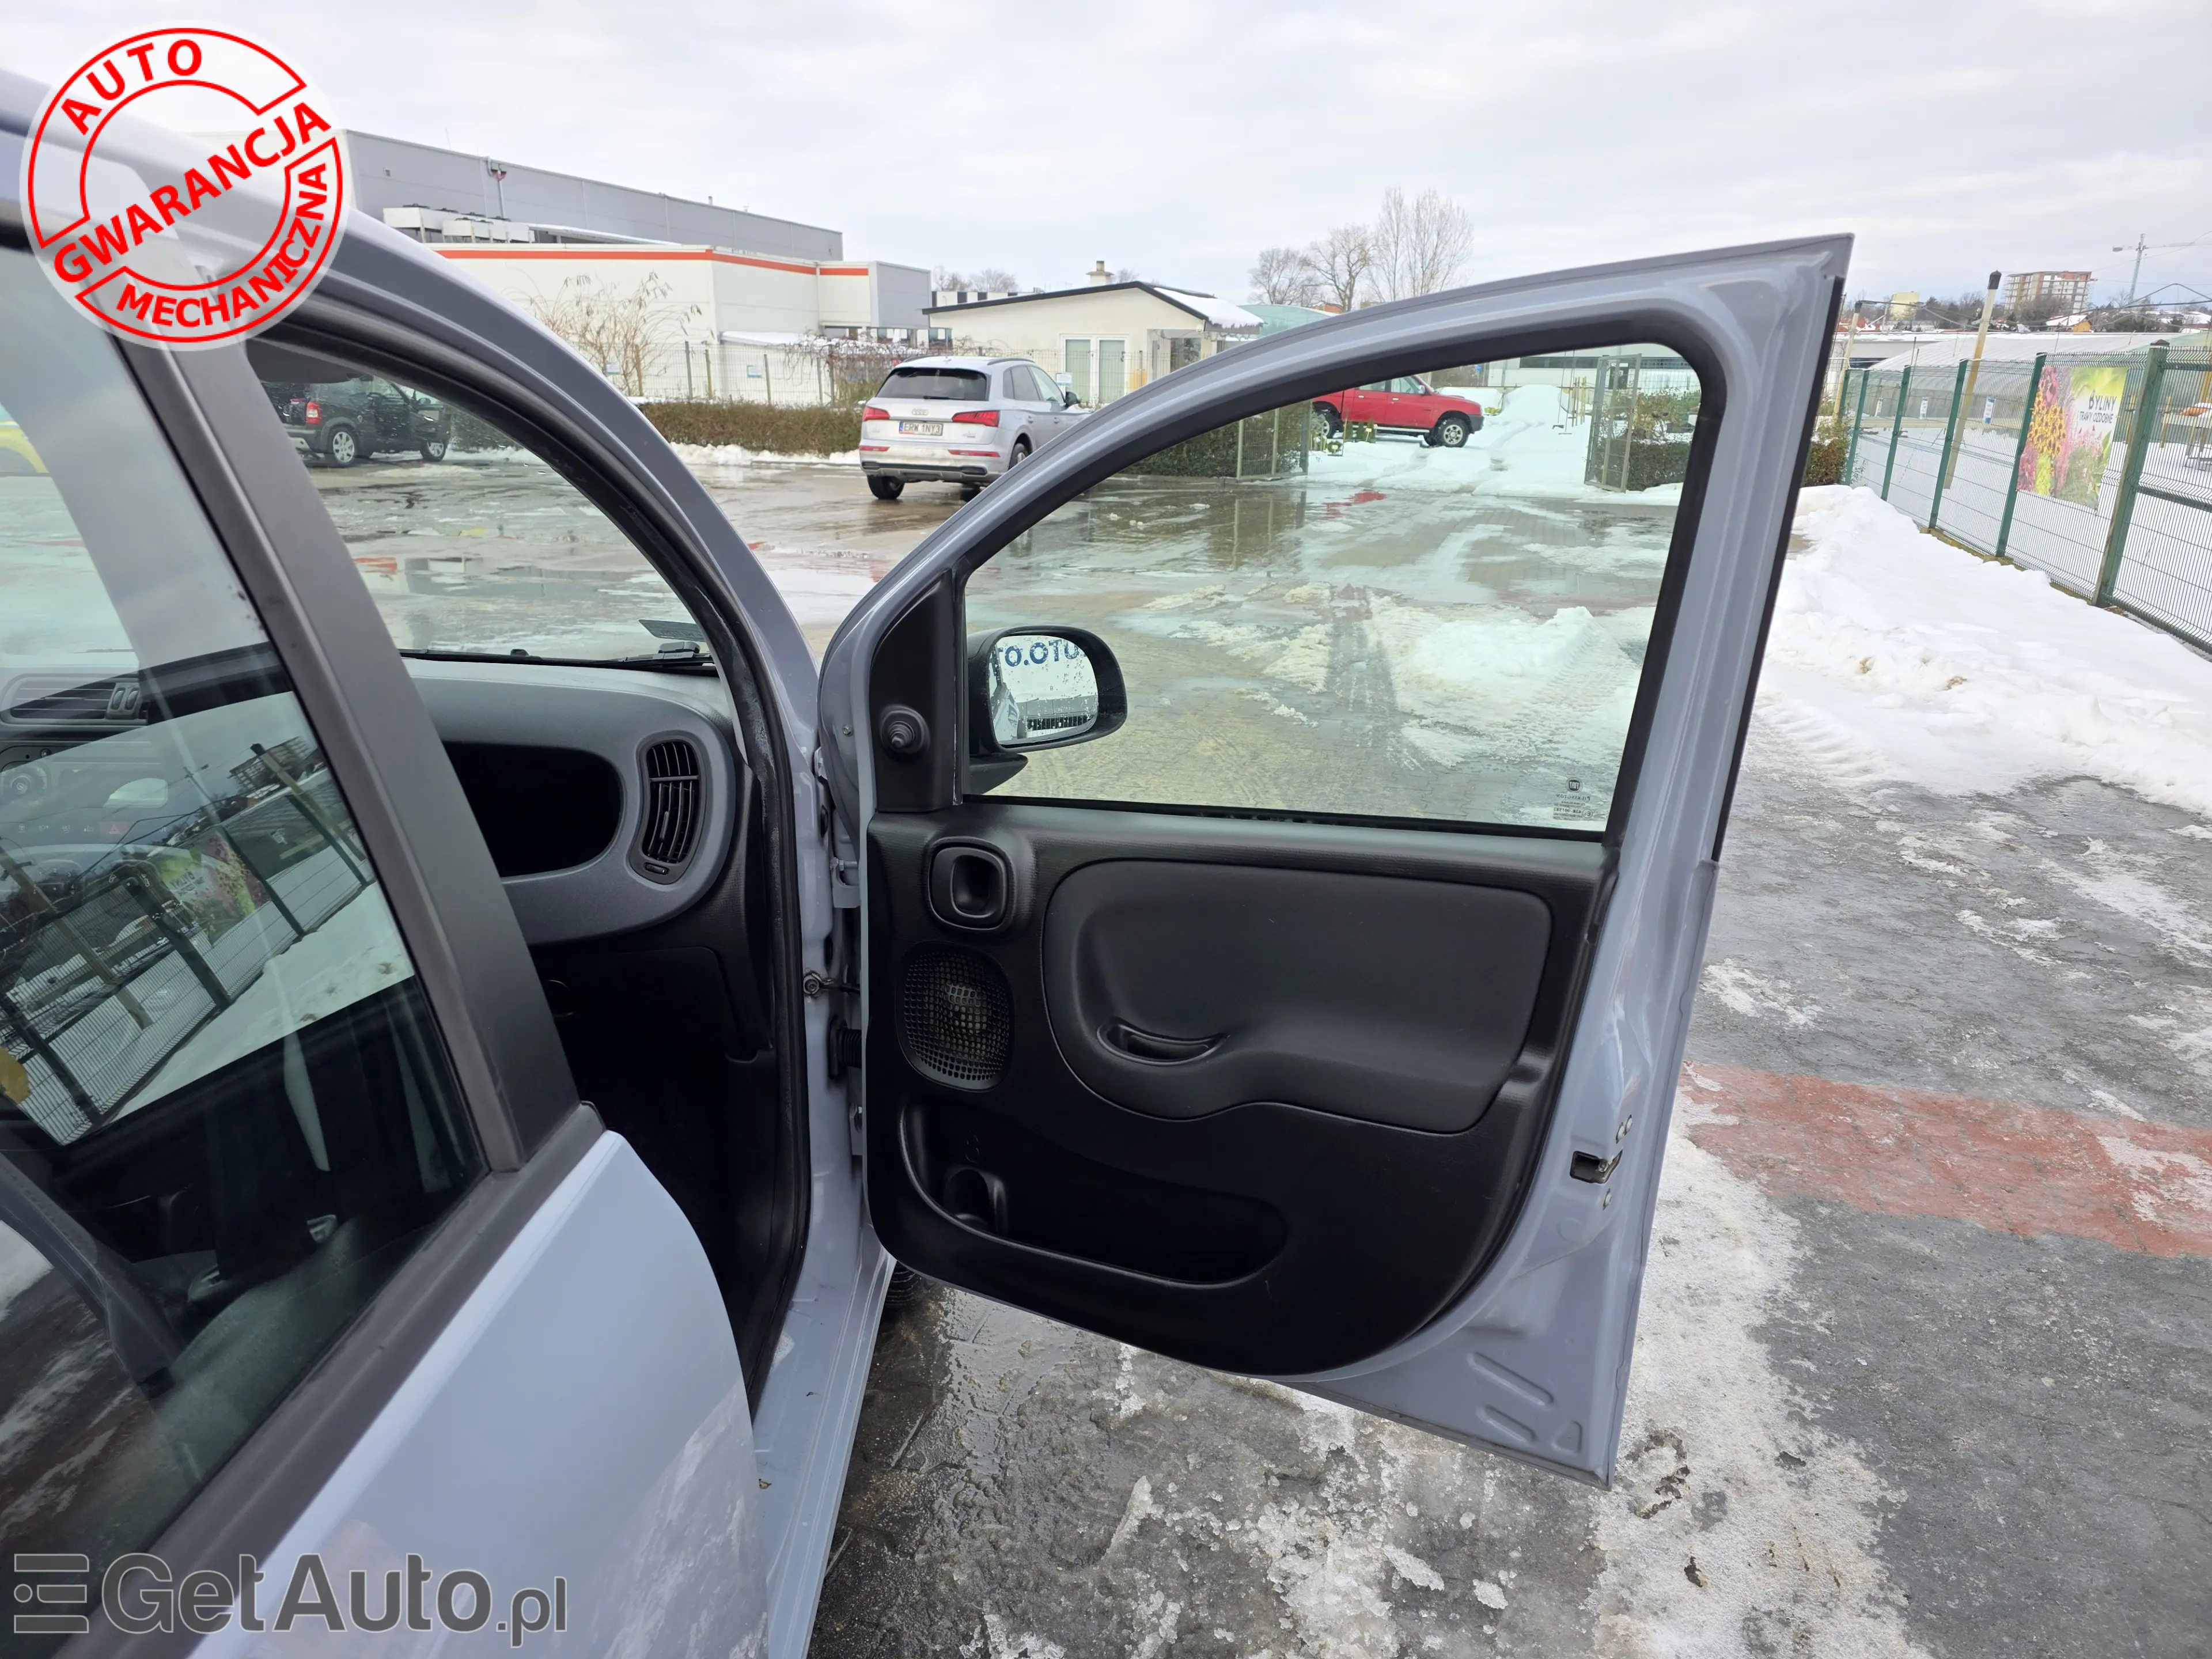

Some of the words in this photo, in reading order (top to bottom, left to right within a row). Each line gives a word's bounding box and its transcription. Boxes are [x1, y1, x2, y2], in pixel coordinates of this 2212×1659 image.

[2088, 389, 2117, 412] BYLINY
[2079, 411, 2093, 422] TRAWY
[2093, 412, 2114, 423] OZDOBNE
[904, 423, 919, 431] ERW
[922, 423, 941, 433] 1NY3
